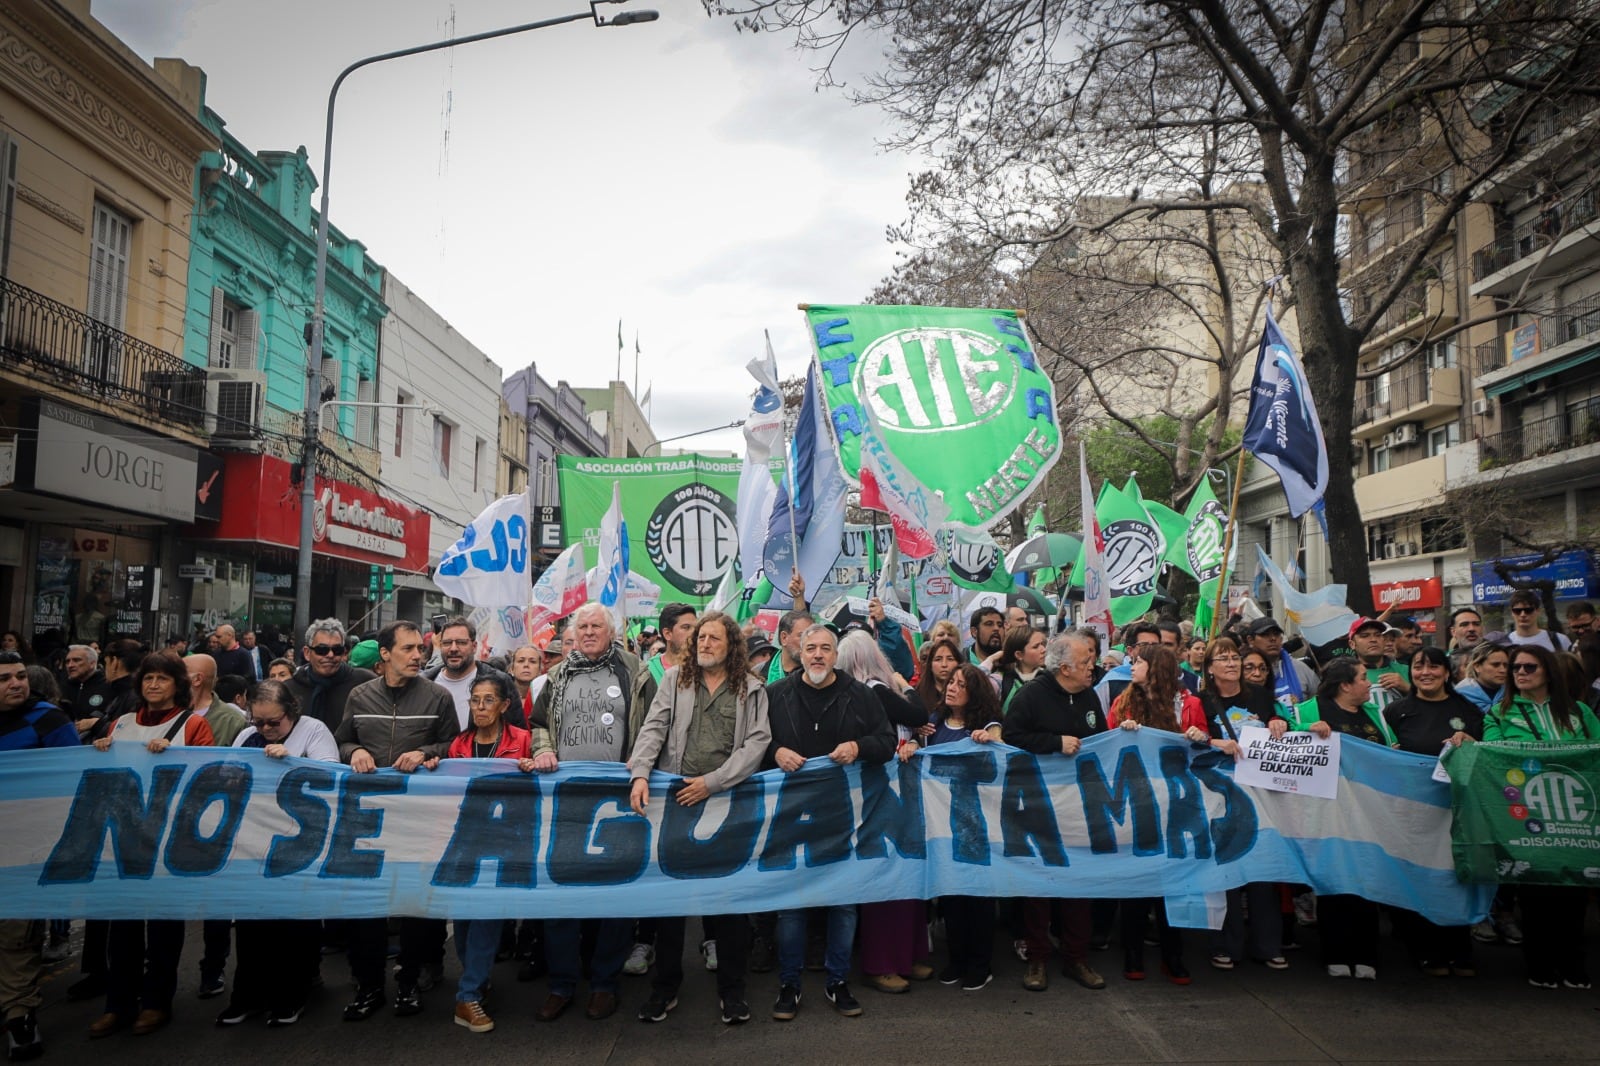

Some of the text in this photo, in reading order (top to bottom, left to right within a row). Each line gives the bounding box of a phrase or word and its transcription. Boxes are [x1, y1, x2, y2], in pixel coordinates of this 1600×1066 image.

[862, 329, 1008, 427] ATE
[81, 442, 164, 492] JORGE
[576, 459, 786, 473] ASOCIACIÓN TRABAJADORES EST
[965, 427, 1056, 520] NORTE
[674, 485, 720, 503] 100 AÑOS
[357, 534, 386, 551] PASTAS
[667, 504, 729, 572] ATE
[1486, 584, 1516, 595] COLDW
[580, 687, 601, 699] LAS
[565, 699, 615, 713] MALVINAS
[575, 713, 596, 724] SON
[1249, 740, 1330, 755] AL PROYECTO DE
[1268, 735, 1312, 745] RECHAZO
[1248, 749, 1329, 767] LEY DE LIBERTAD
[1260, 761, 1314, 777] EDUCATIVA
[1524, 771, 1589, 822] ATE
[37, 760, 254, 886] NO
[263, 766, 411, 879] SE
[1545, 823, 1592, 836] Buenos
